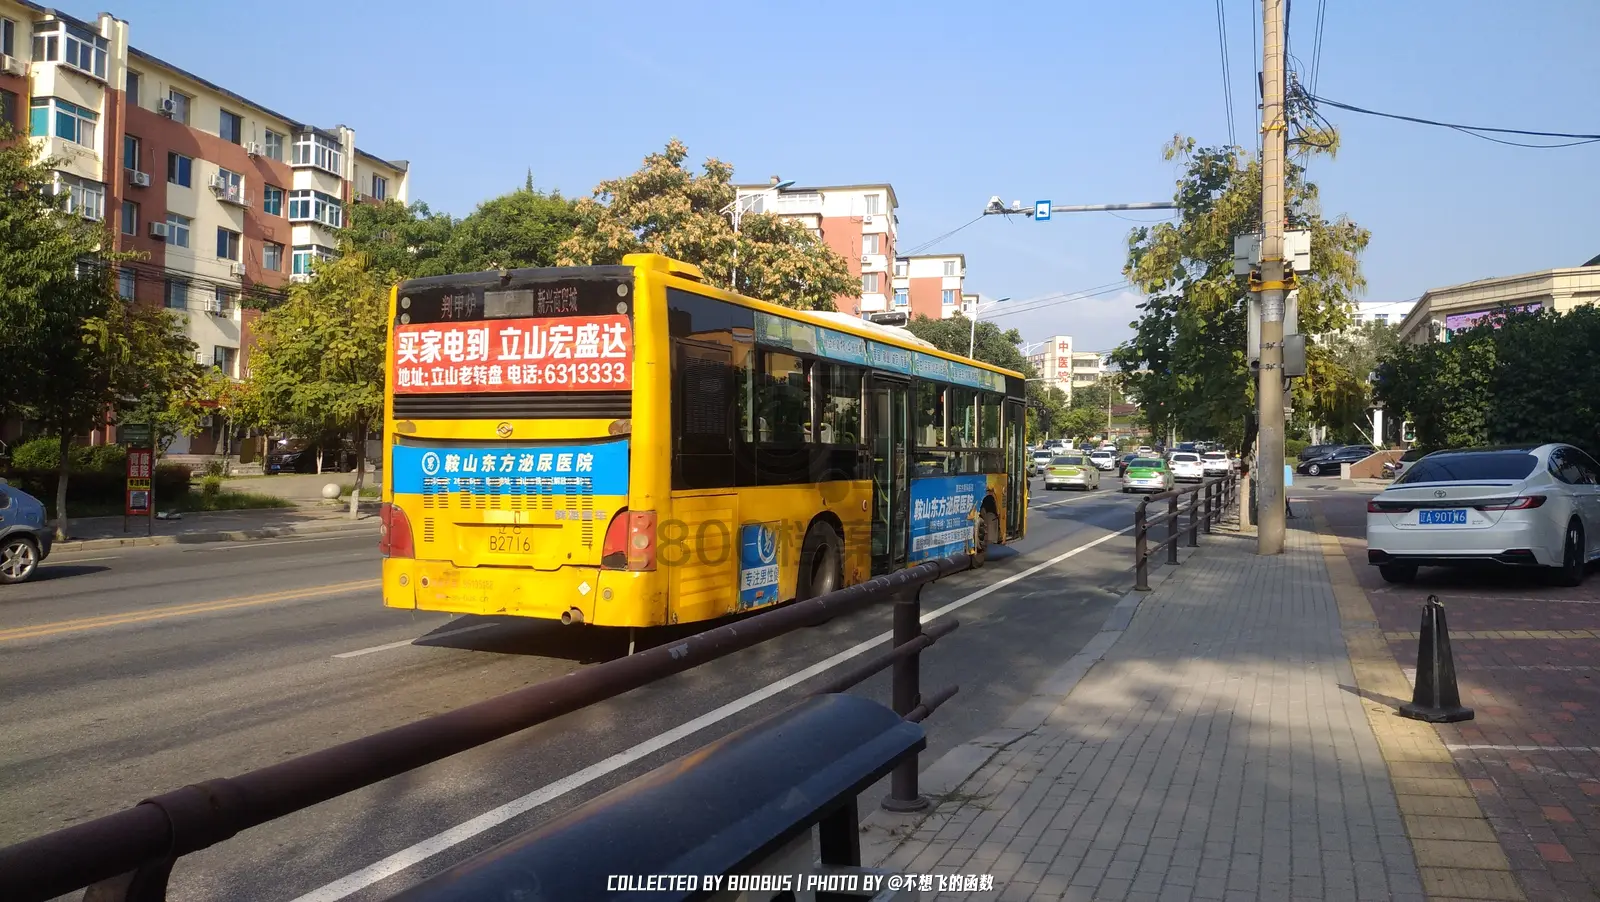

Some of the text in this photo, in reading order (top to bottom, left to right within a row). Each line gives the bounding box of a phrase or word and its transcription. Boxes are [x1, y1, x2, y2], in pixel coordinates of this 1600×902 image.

[397, 323, 628, 364] 买家电到 立山宏盛达
[397, 362, 625, 387] 地址:立山老转盘 电话:6313333
[1057, 340, 1069, 383] 中医院
[444, 452, 594, 473] 鞍山东方泌尿医院
[913, 494, 975, 521] 鞍山东方泌尿医院
[489, 535, 531, 551] B2716
